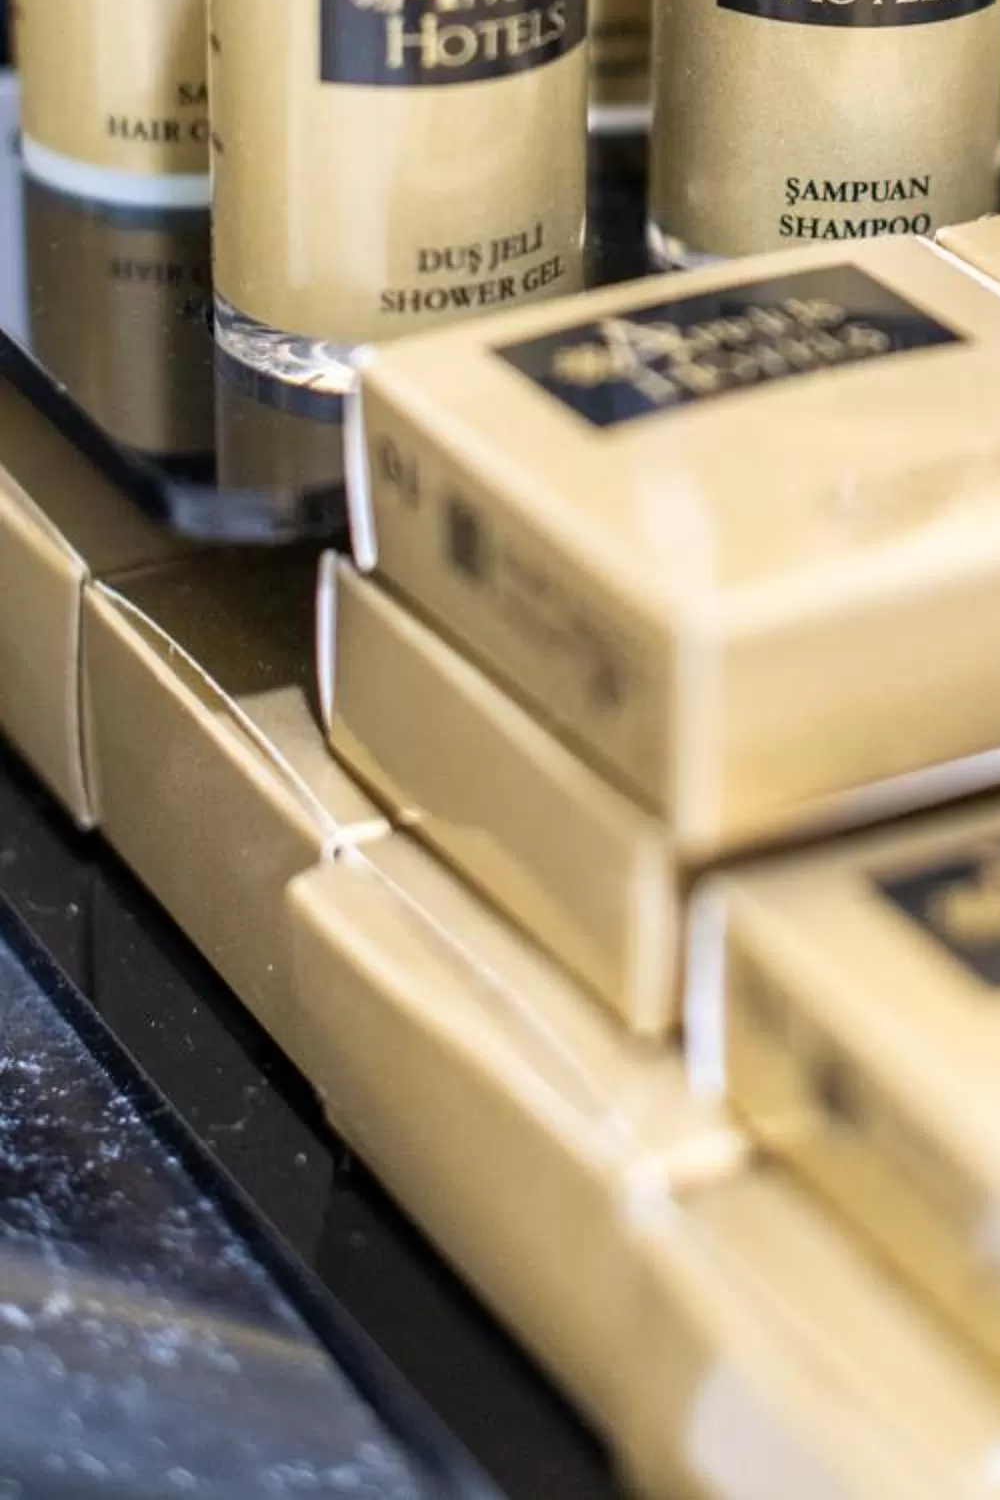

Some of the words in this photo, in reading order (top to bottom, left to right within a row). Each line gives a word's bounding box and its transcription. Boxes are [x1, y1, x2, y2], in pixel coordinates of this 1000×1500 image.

[785, 175, 931, 206] ŞAMPUAN
[779, 213, 932, 239] SHAMPOO
[379, 275, 517, 313] SHOWER
[522, 255, 567, 293] GEL
